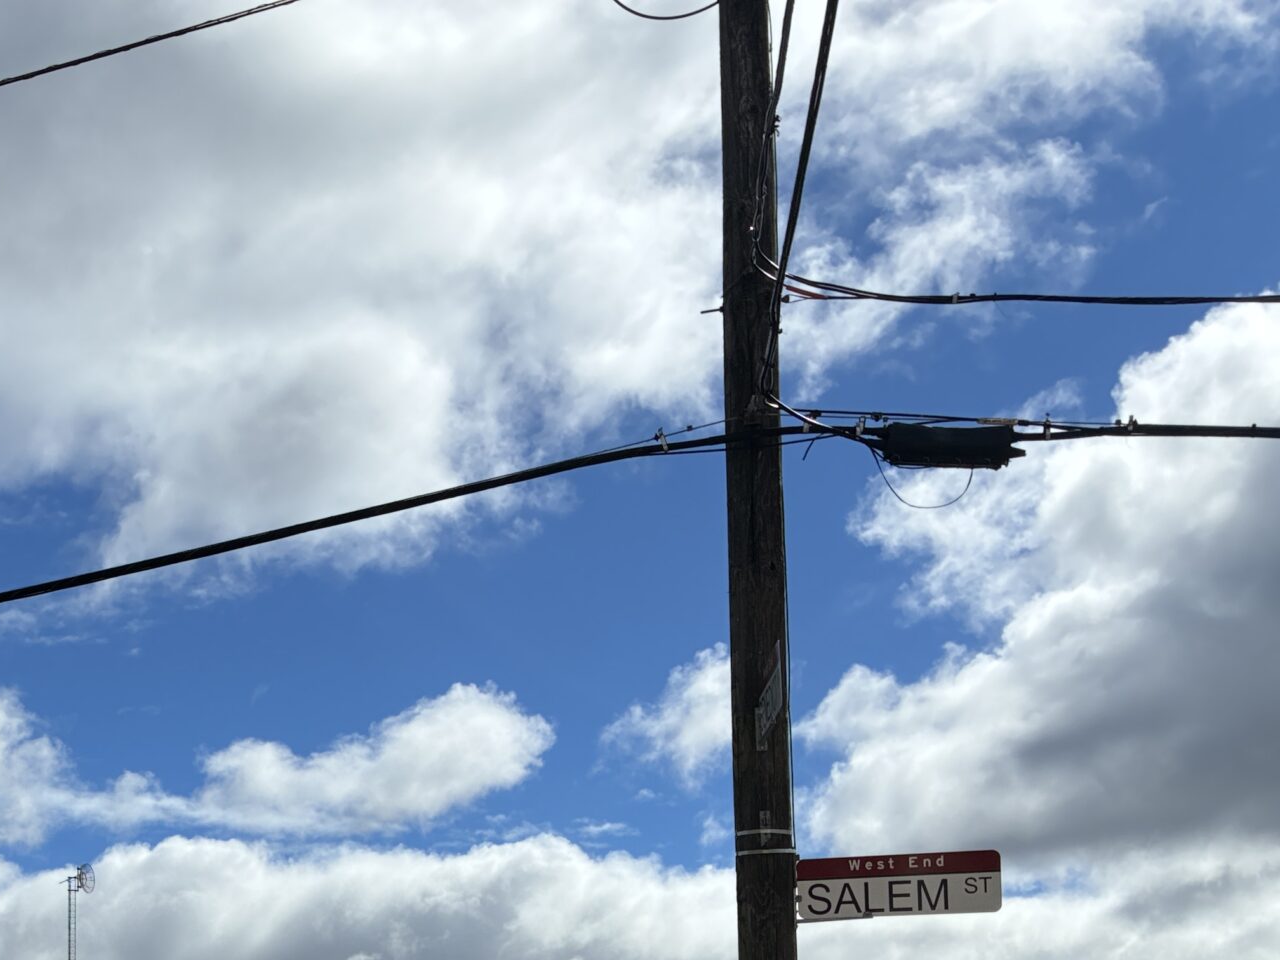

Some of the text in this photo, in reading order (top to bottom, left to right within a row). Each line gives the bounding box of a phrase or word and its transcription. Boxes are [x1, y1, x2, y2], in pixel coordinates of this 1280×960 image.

[848, 855, 945, 871] West End
[807, 876, 992, 915] SALEM ST
